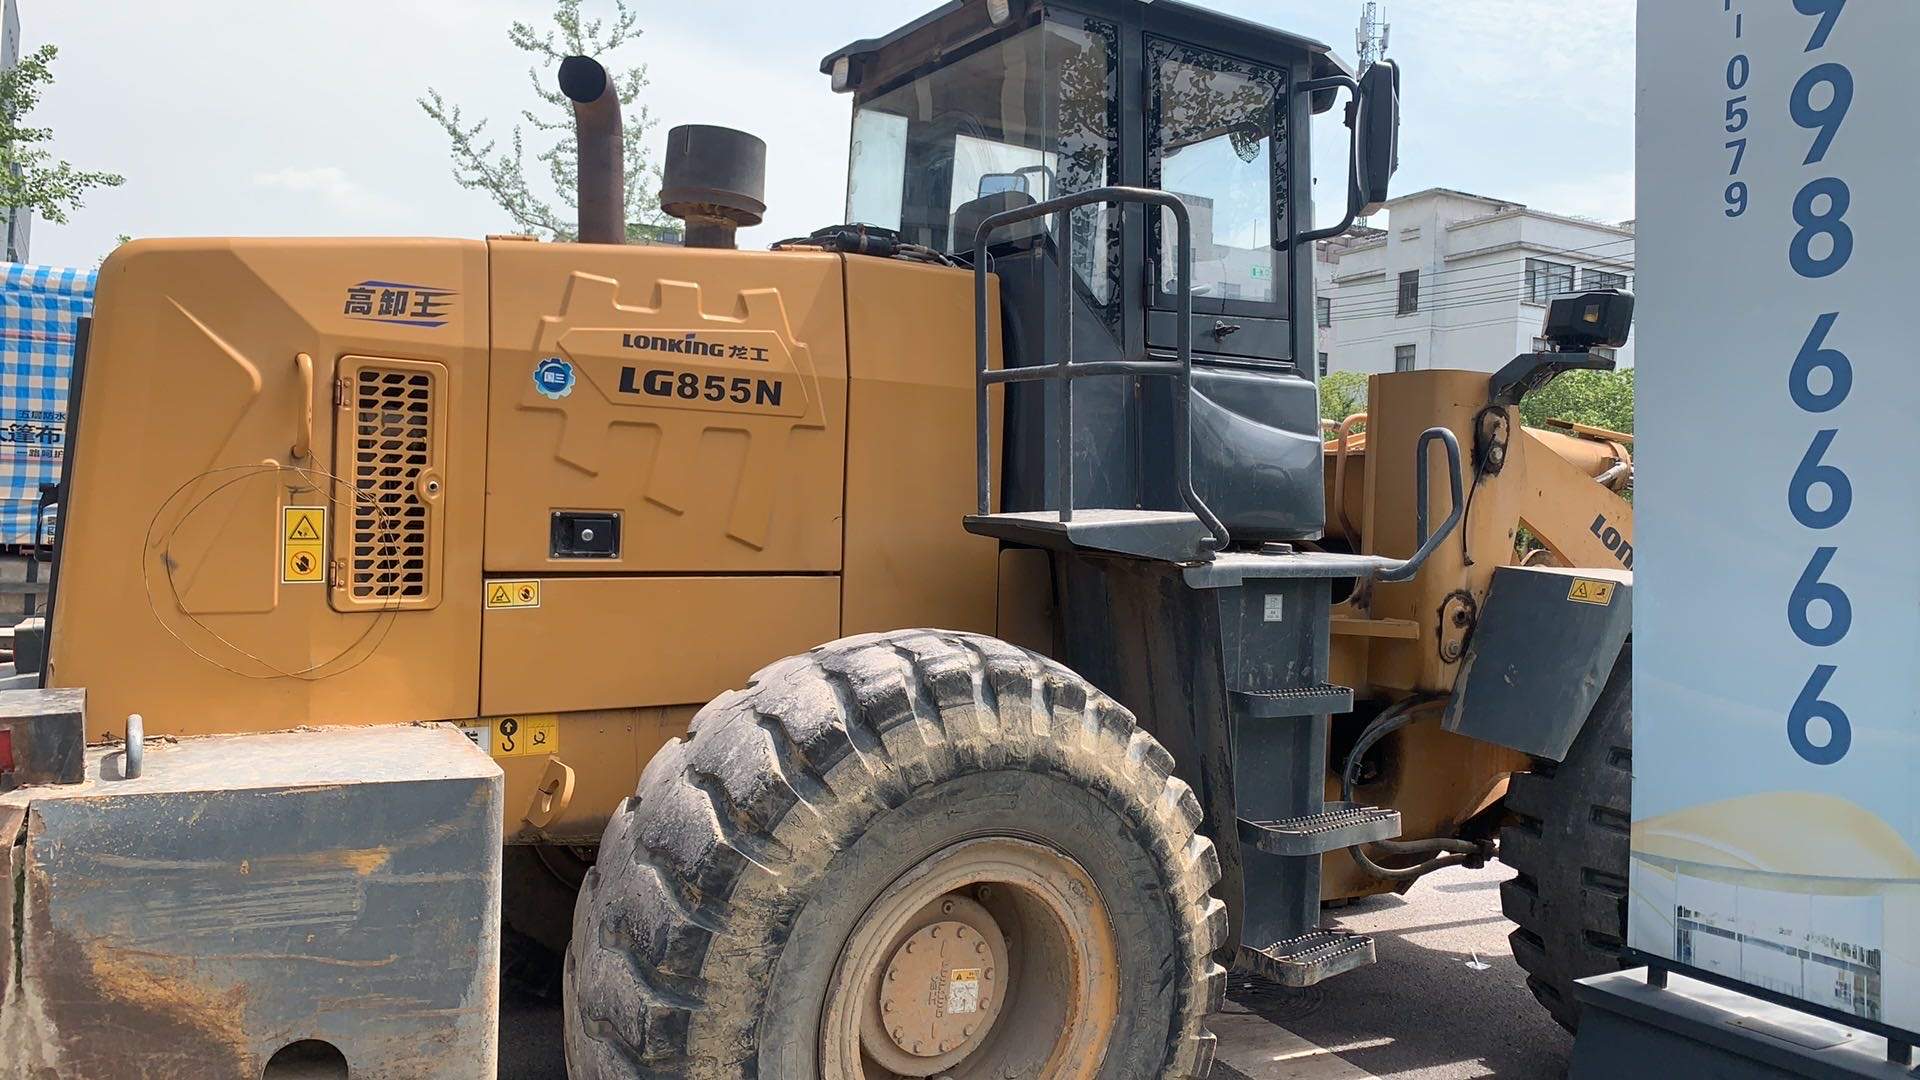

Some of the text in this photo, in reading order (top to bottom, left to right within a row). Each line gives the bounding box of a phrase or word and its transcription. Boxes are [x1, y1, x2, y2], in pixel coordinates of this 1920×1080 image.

[344, 287, 460, 318] 高卸王
[728, 345, 769, 362] 龙工
[618, 366, 783, 406] LG855N
[1590, 513, 1633, 571] LON
